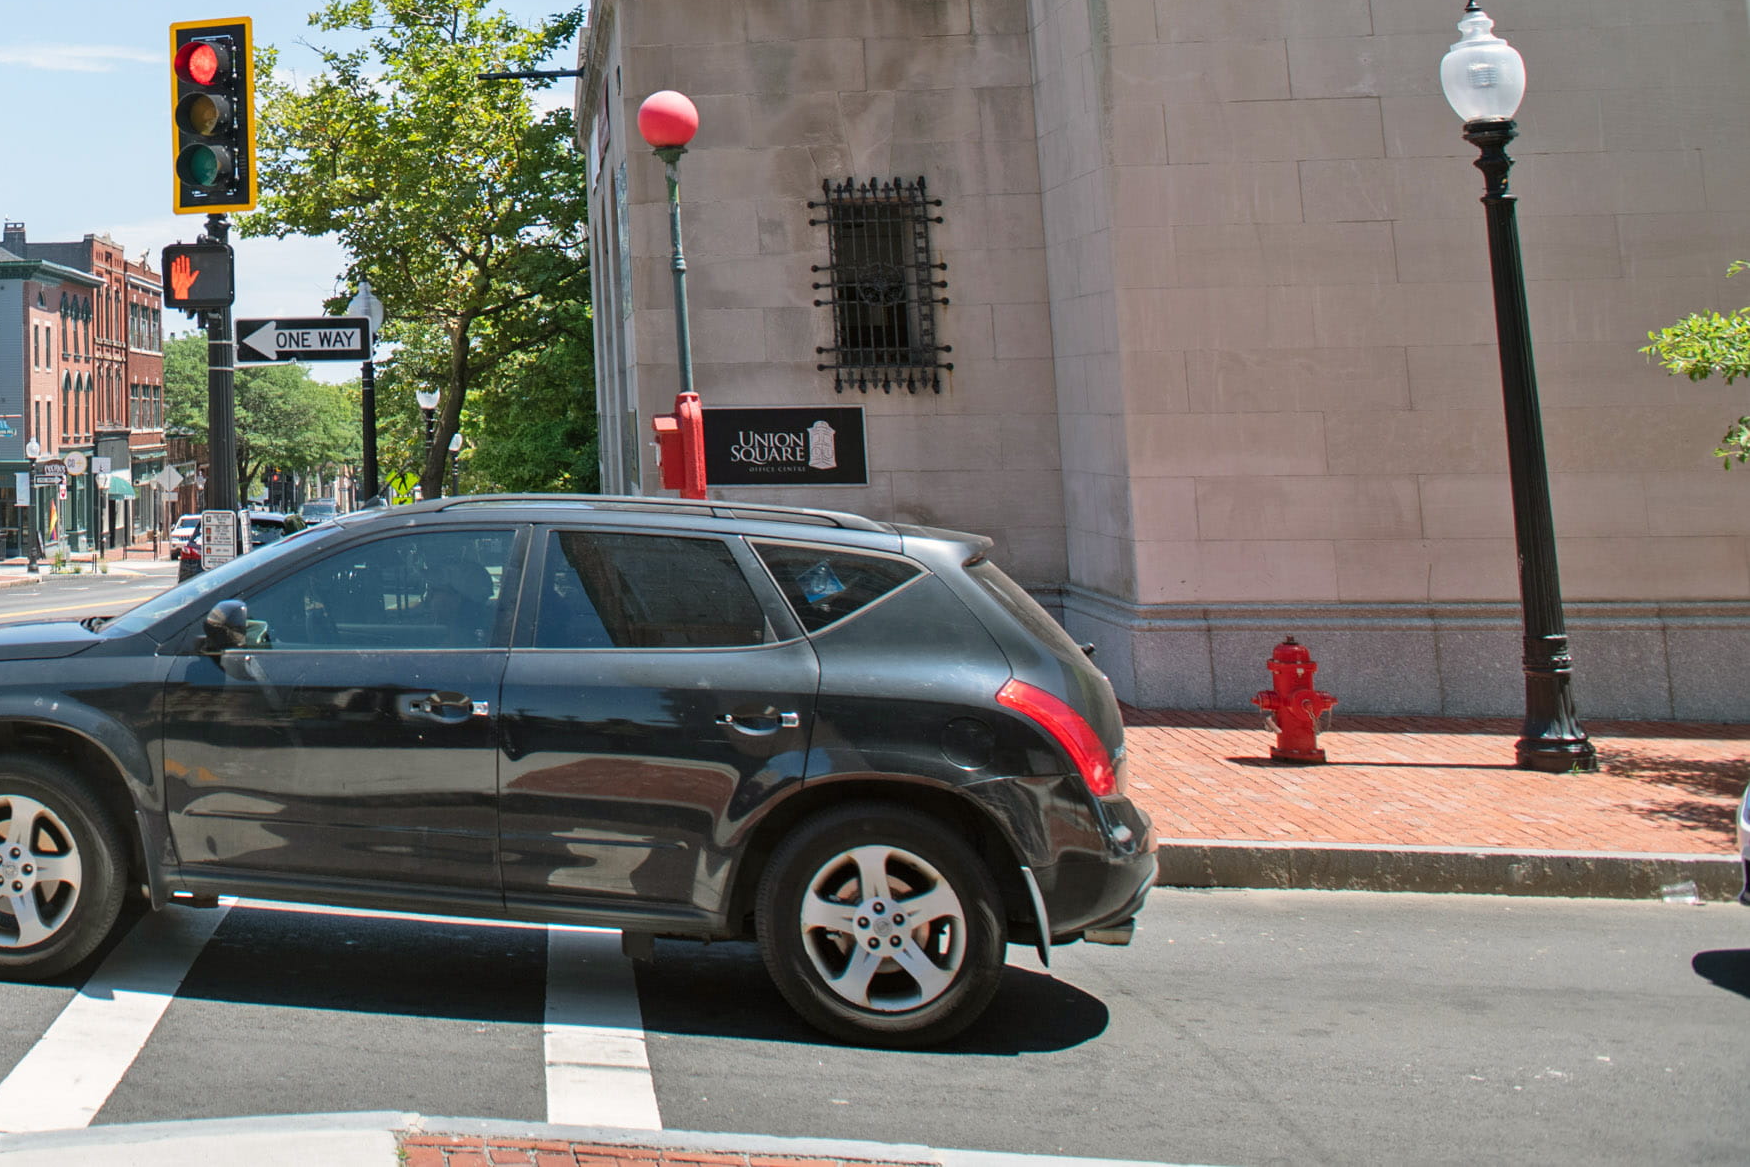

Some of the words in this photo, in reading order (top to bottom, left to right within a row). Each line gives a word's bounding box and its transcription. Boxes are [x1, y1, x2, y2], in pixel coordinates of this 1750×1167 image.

[276, 331, 312, 348] ONE
[318, 330, 355, 348] WAY
[739, 430, 804, 447] UNION
[731, 445, 805, 464] SQUARE
